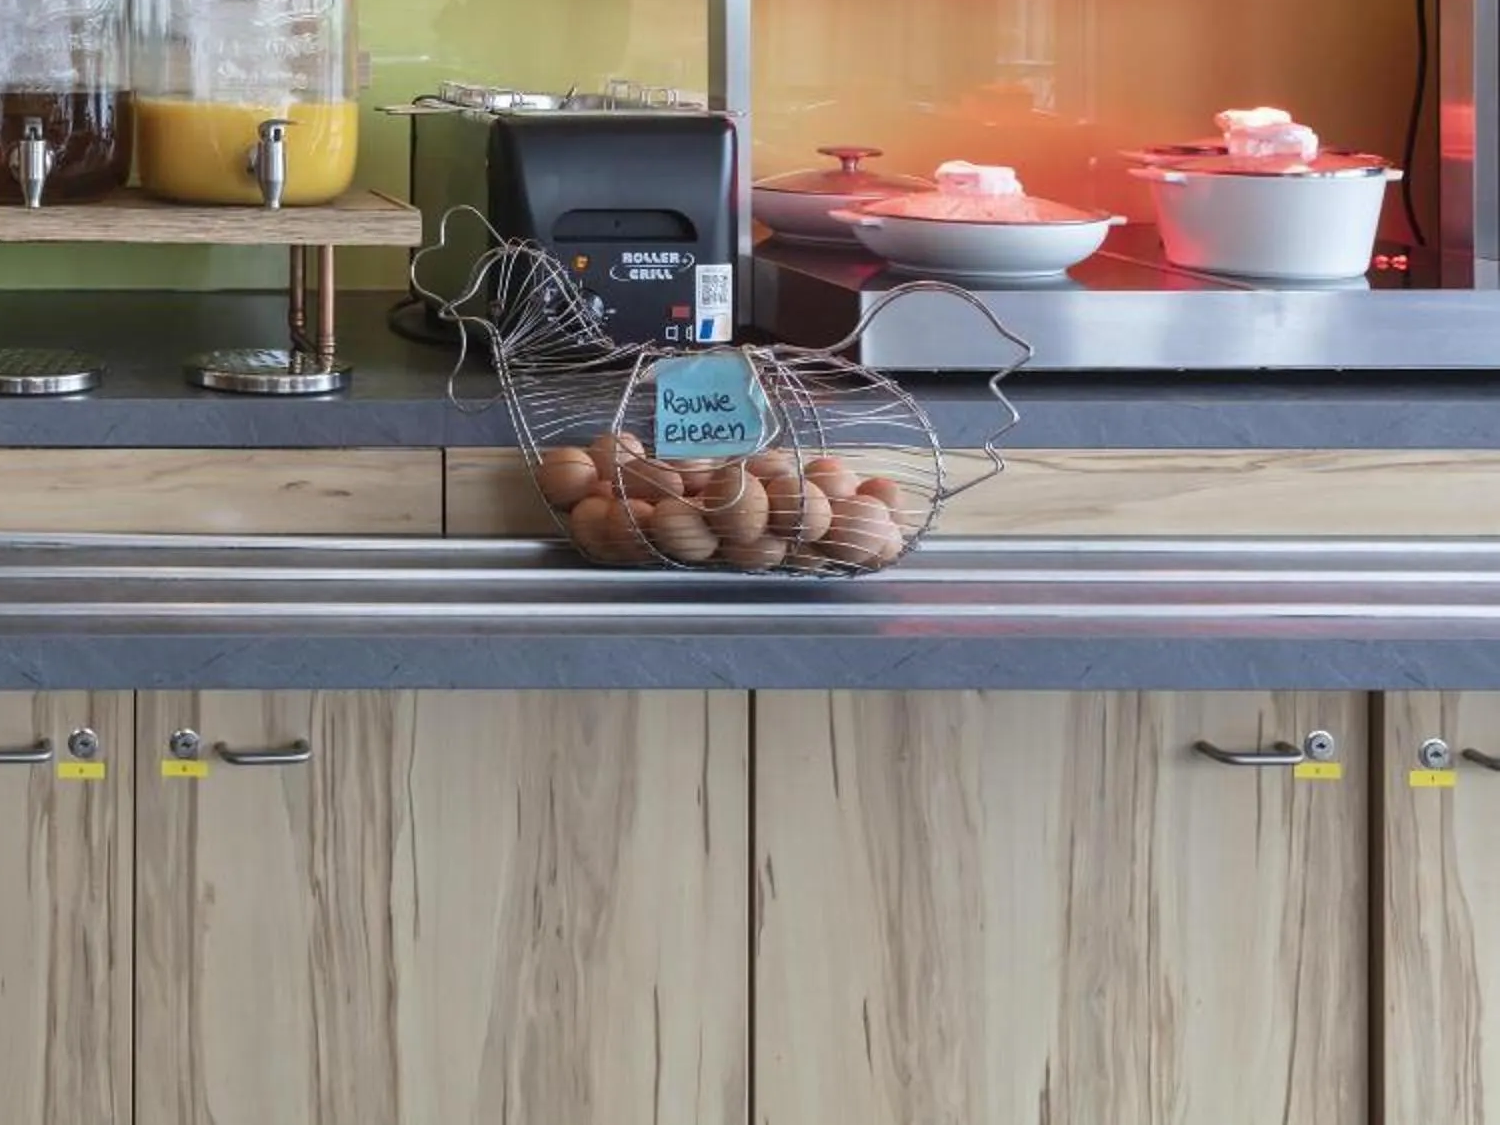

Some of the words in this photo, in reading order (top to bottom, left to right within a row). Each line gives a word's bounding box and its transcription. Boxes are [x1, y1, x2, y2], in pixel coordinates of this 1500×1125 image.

[622, 251, 681, 264] ROLLER
[628, 268, 674, 280] GRILL
[663, 387, 736, 415] Rauwe
